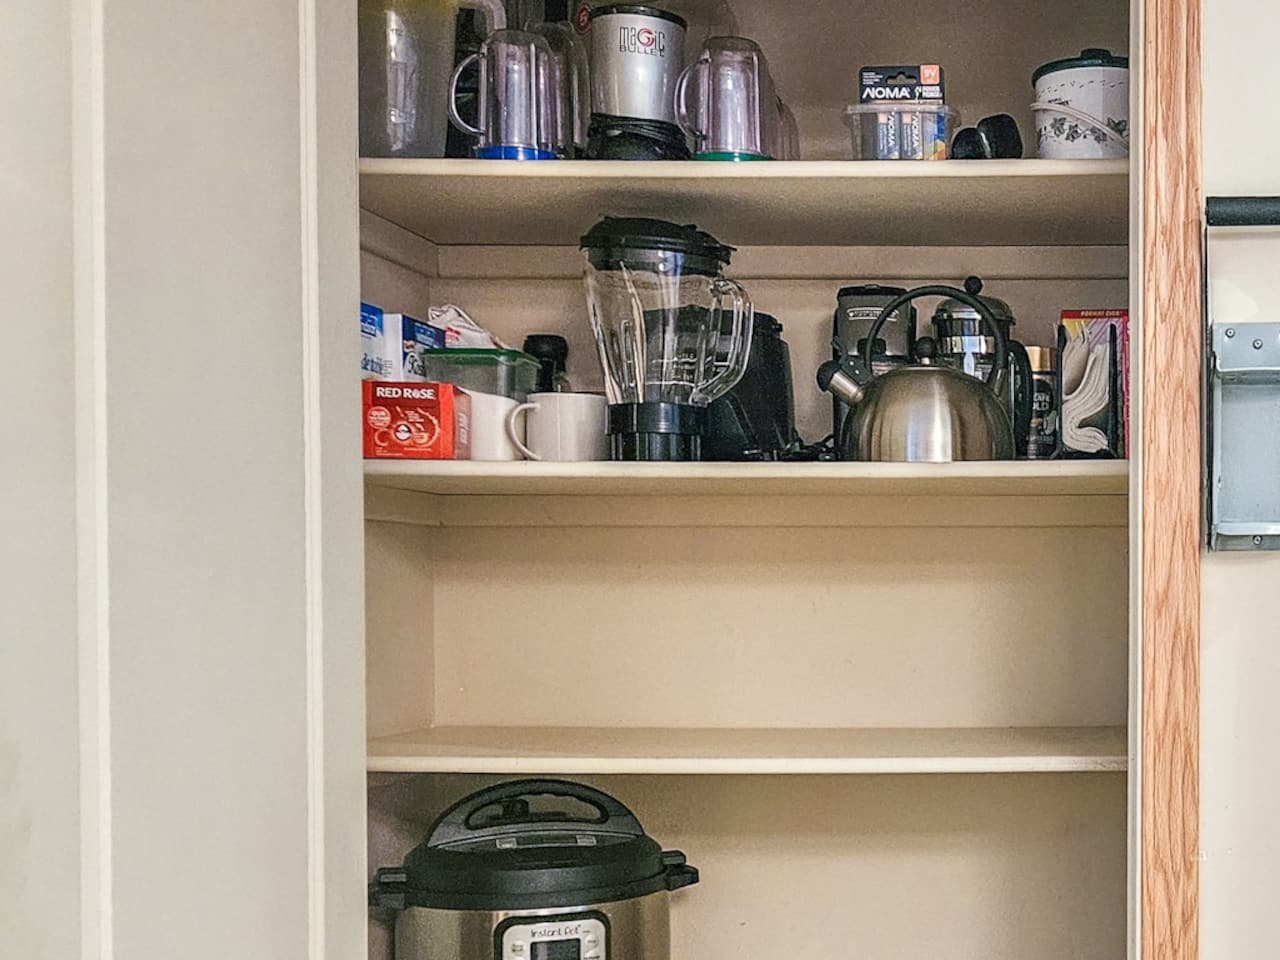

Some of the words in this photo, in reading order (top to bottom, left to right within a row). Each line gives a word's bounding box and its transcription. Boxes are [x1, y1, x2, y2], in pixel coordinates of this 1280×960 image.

[862, 87, 910, 98] NOMA
[376, 387, 402, 398] RED
[403, 387, 437, 400] ROSE
[530, 928, 561, 938] Instant
